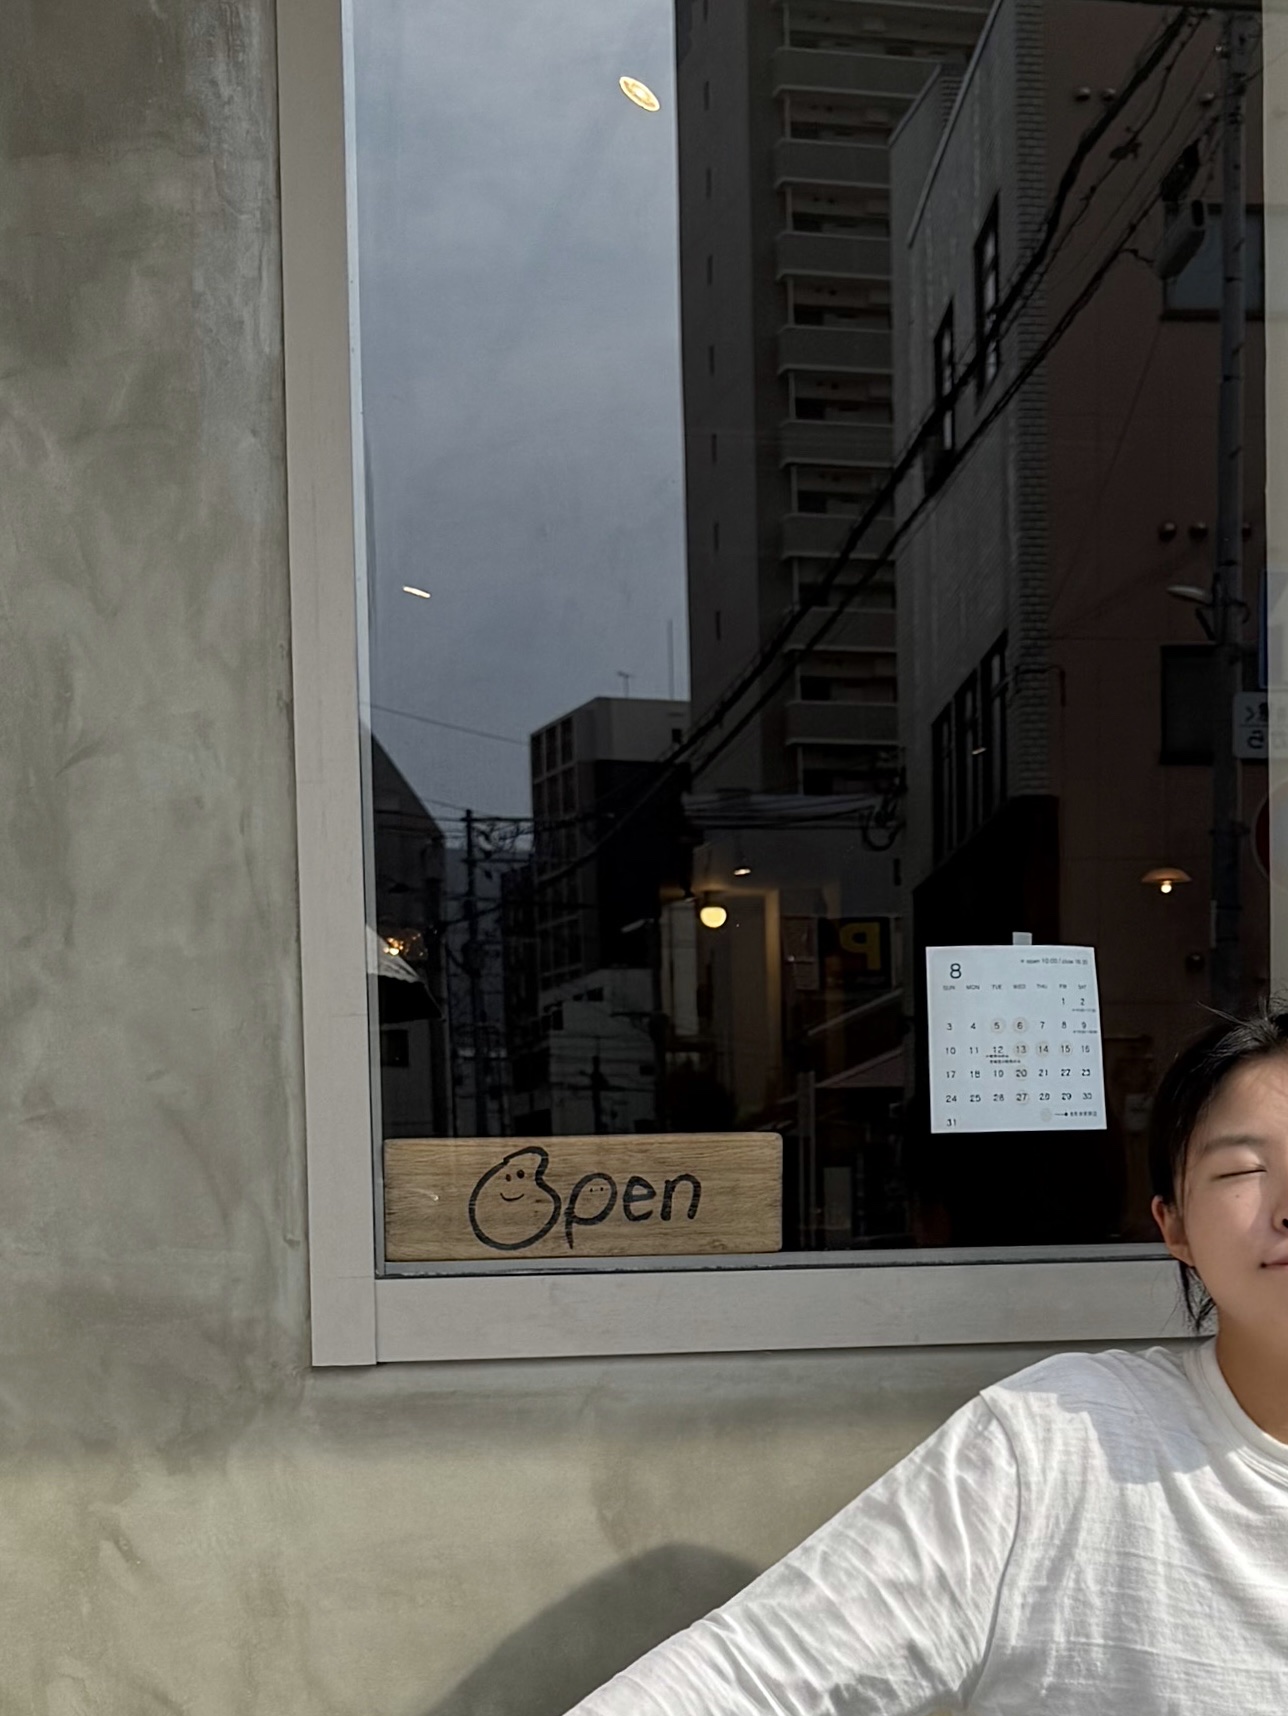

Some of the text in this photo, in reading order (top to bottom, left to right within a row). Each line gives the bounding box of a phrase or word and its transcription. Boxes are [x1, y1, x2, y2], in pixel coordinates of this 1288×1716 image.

[949, 962, 962, 980] 8
[1080, 997, 1085, 1006] 2
[946, 1021, 1087, 1031] 3 4 5 6 7 8 9
[945, 1045, 1091, 1055] 10 11 12 13 14 15 16
[946, 1071, 956, 1079] 17
[970, 1070, 981, 1079] 18
[1015, 1069, 1028, 1078] 20
[1038, 1069, 1049, 1077] 21
[1060, 1068, 1071, 1077] 22
[945, 1095, 957, 1103] 24
[969, 1094, 981, 1103] 25
[993, 1093, 1005, 1102] 26
[1016, 1093, 1028, 1102] 27
[1061, 1092, 1072, 1101] 29
[1082, 1092, 1093, 1100] 30
[946, 1119, 957, 1127] 31
[468, 1145, 703, 1251] Open
